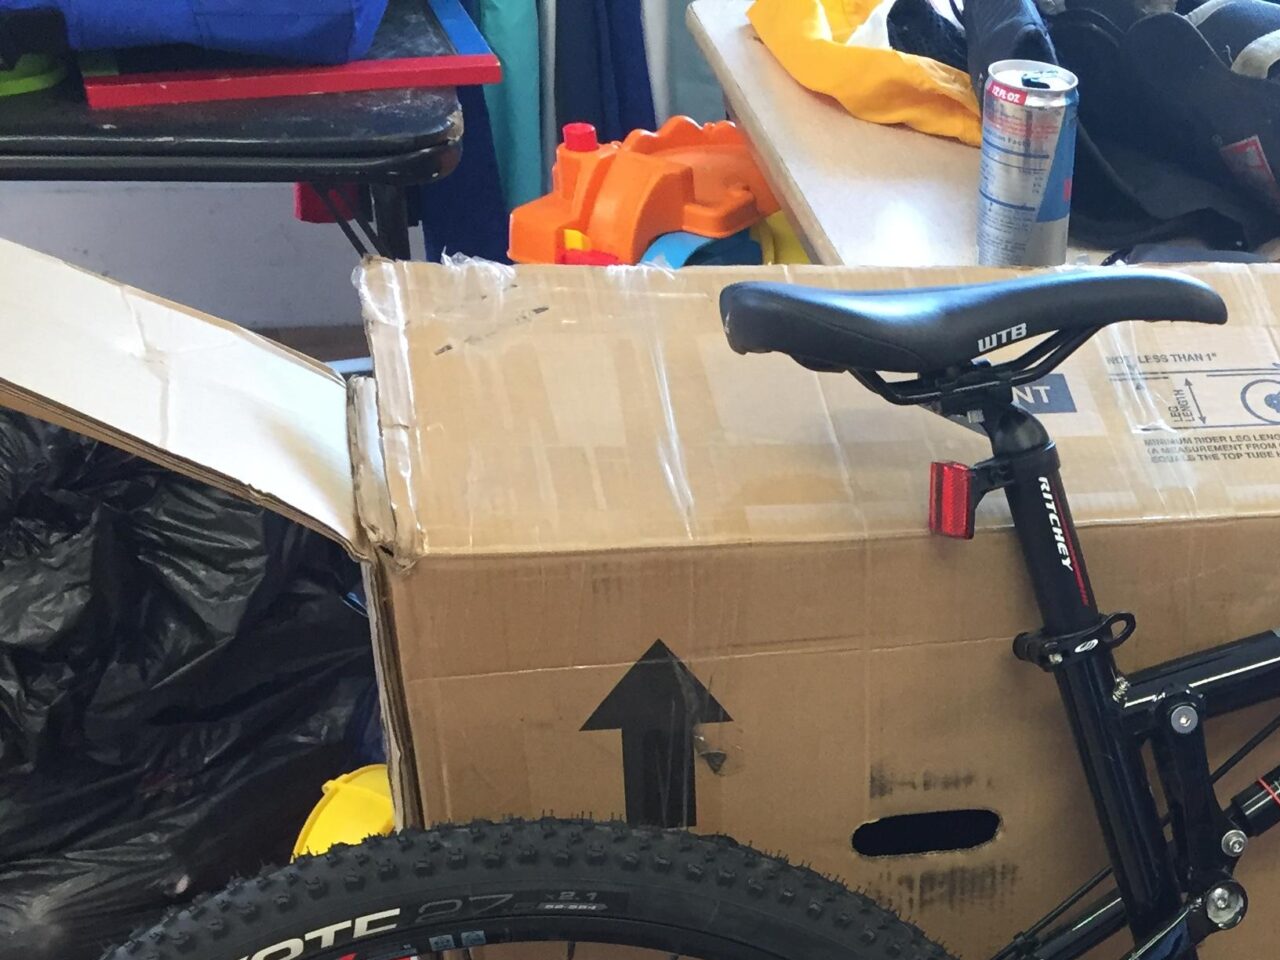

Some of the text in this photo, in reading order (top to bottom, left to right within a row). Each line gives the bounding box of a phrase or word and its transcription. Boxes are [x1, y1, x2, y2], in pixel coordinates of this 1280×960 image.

[978, 323, 1026, 352] WTB
[1138, 354, 1168, 364] LESS
[1172, 353, 1203, 363] THAN
[1194, 436, 1227, 445] RIDER
[1229, 434, 1250, 443] LEG
[1246, 442, 1276, 451] FROM
[1199, 453, 1220, 461] THE
[1223, 452, 1244, 461] TOP
[1246, 451, 1274, 460] TUBE
[1038, 476, 1073, 571] RITCHEY
